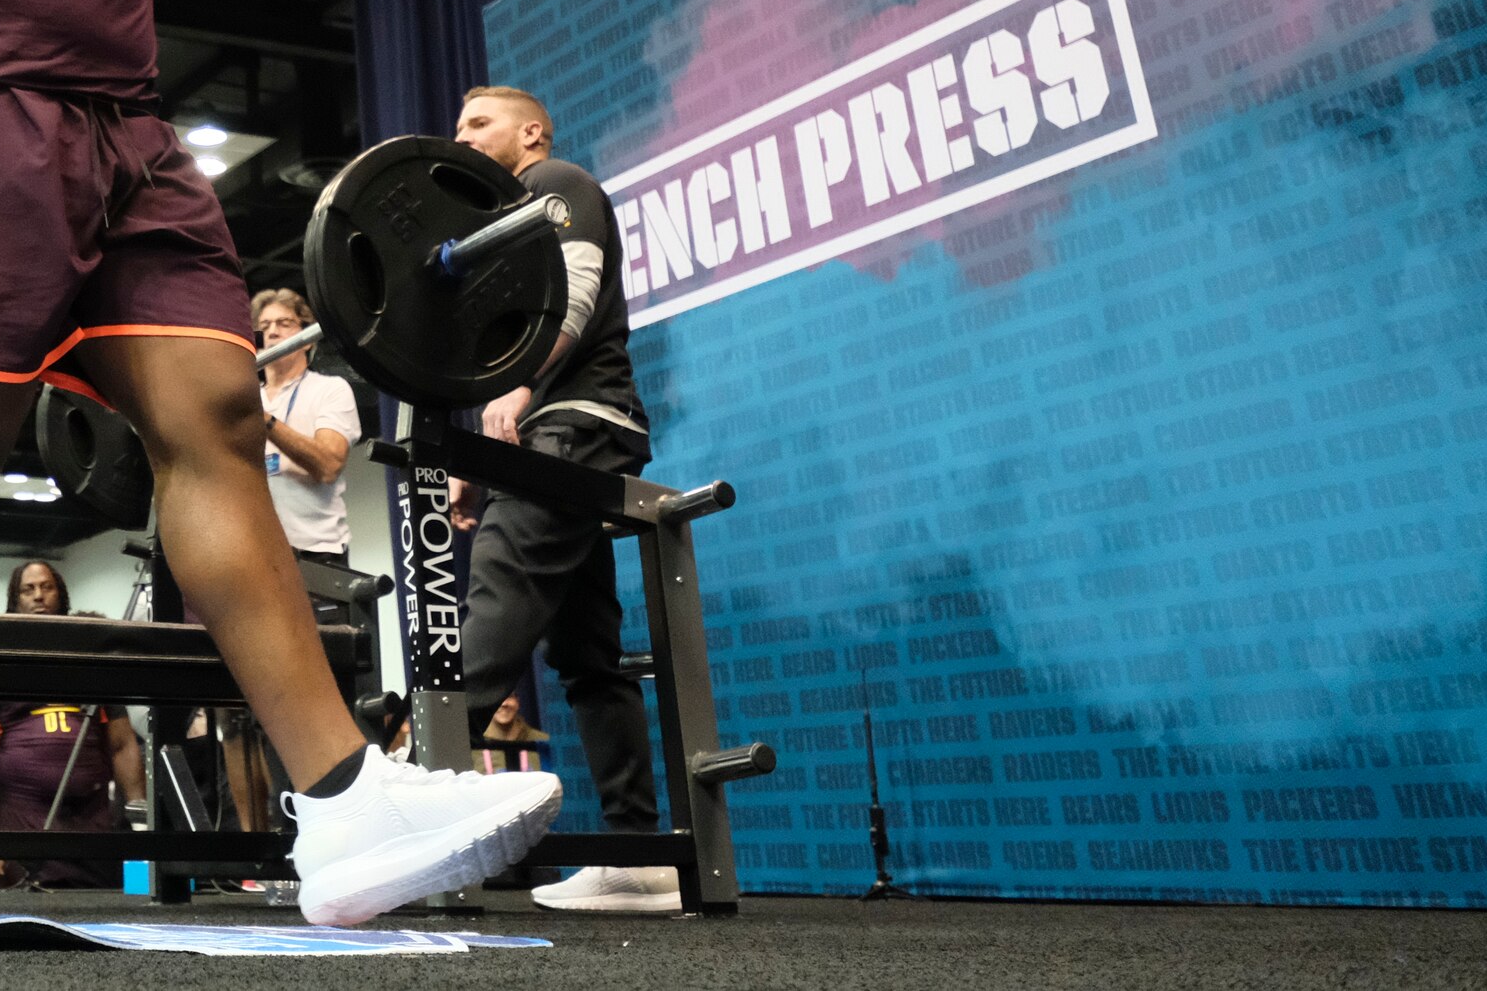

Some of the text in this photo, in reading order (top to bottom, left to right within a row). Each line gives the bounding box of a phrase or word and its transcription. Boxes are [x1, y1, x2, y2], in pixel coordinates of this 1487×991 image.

[613, 134, 792, 301] ENCH
[398, 481, 410, 497] PRO
[415, 467, 448, 485] PRO
[399, 497, 420, 637] POWER
[417, 487, 461, 656] POWER
[740, 615, 811, 648] RAIDERS
[1076, 555, 1200, 601] COWBOYS
[1209, 537, 1316, 582] GIANTS
[1326, 517, 1444, 565] EAGLES
[733, 657, 775, 685] HERE
[780, 649, 837, 680] BEARS
[843, 641, 899, 672] LIONS
[906, 628, 1000, 665] PACKERS
[737, 692, 792, 721] 49ERS
[798, 681, 899, 715] SEAHAWKS
[907, 676, 946, 705] THE
[946, 667, 1030, 701] FUTURE
[1200, 640, 1281, 678] BILLS
[782, 725, 849, 754] FUTURE
[925, 714, 981, 744] HERE
[987, 706, 1077, 740] RAVENS
[886, 755, 995, 787] CHARGERS
[1002, 749, 1103, 782] RAIDERS
[1110, 745, 1162, 777] THE
[1390, 726, 1481, 764] HERE
[800, 804, 835, 830] THE
[910, 798, 991, 827] STARTS
[993, 796, 1051, 826] HERE
[1059, 793, 1141, 824] BEARS
[1149, 789, 1230, 822] LIONS
[1240, 784, 1380, 820] PACKERS
[764, 843, 809, 868] HERE
[928, 841, 993, 869] RAMS
[1000, 840, 1077, 869] 49ERS
[1086, 838, 1231, 870] SEAHAWKS
[1240, 837, 1300, 870] THE
[1300, 836, 1425, 870] FUTURE
